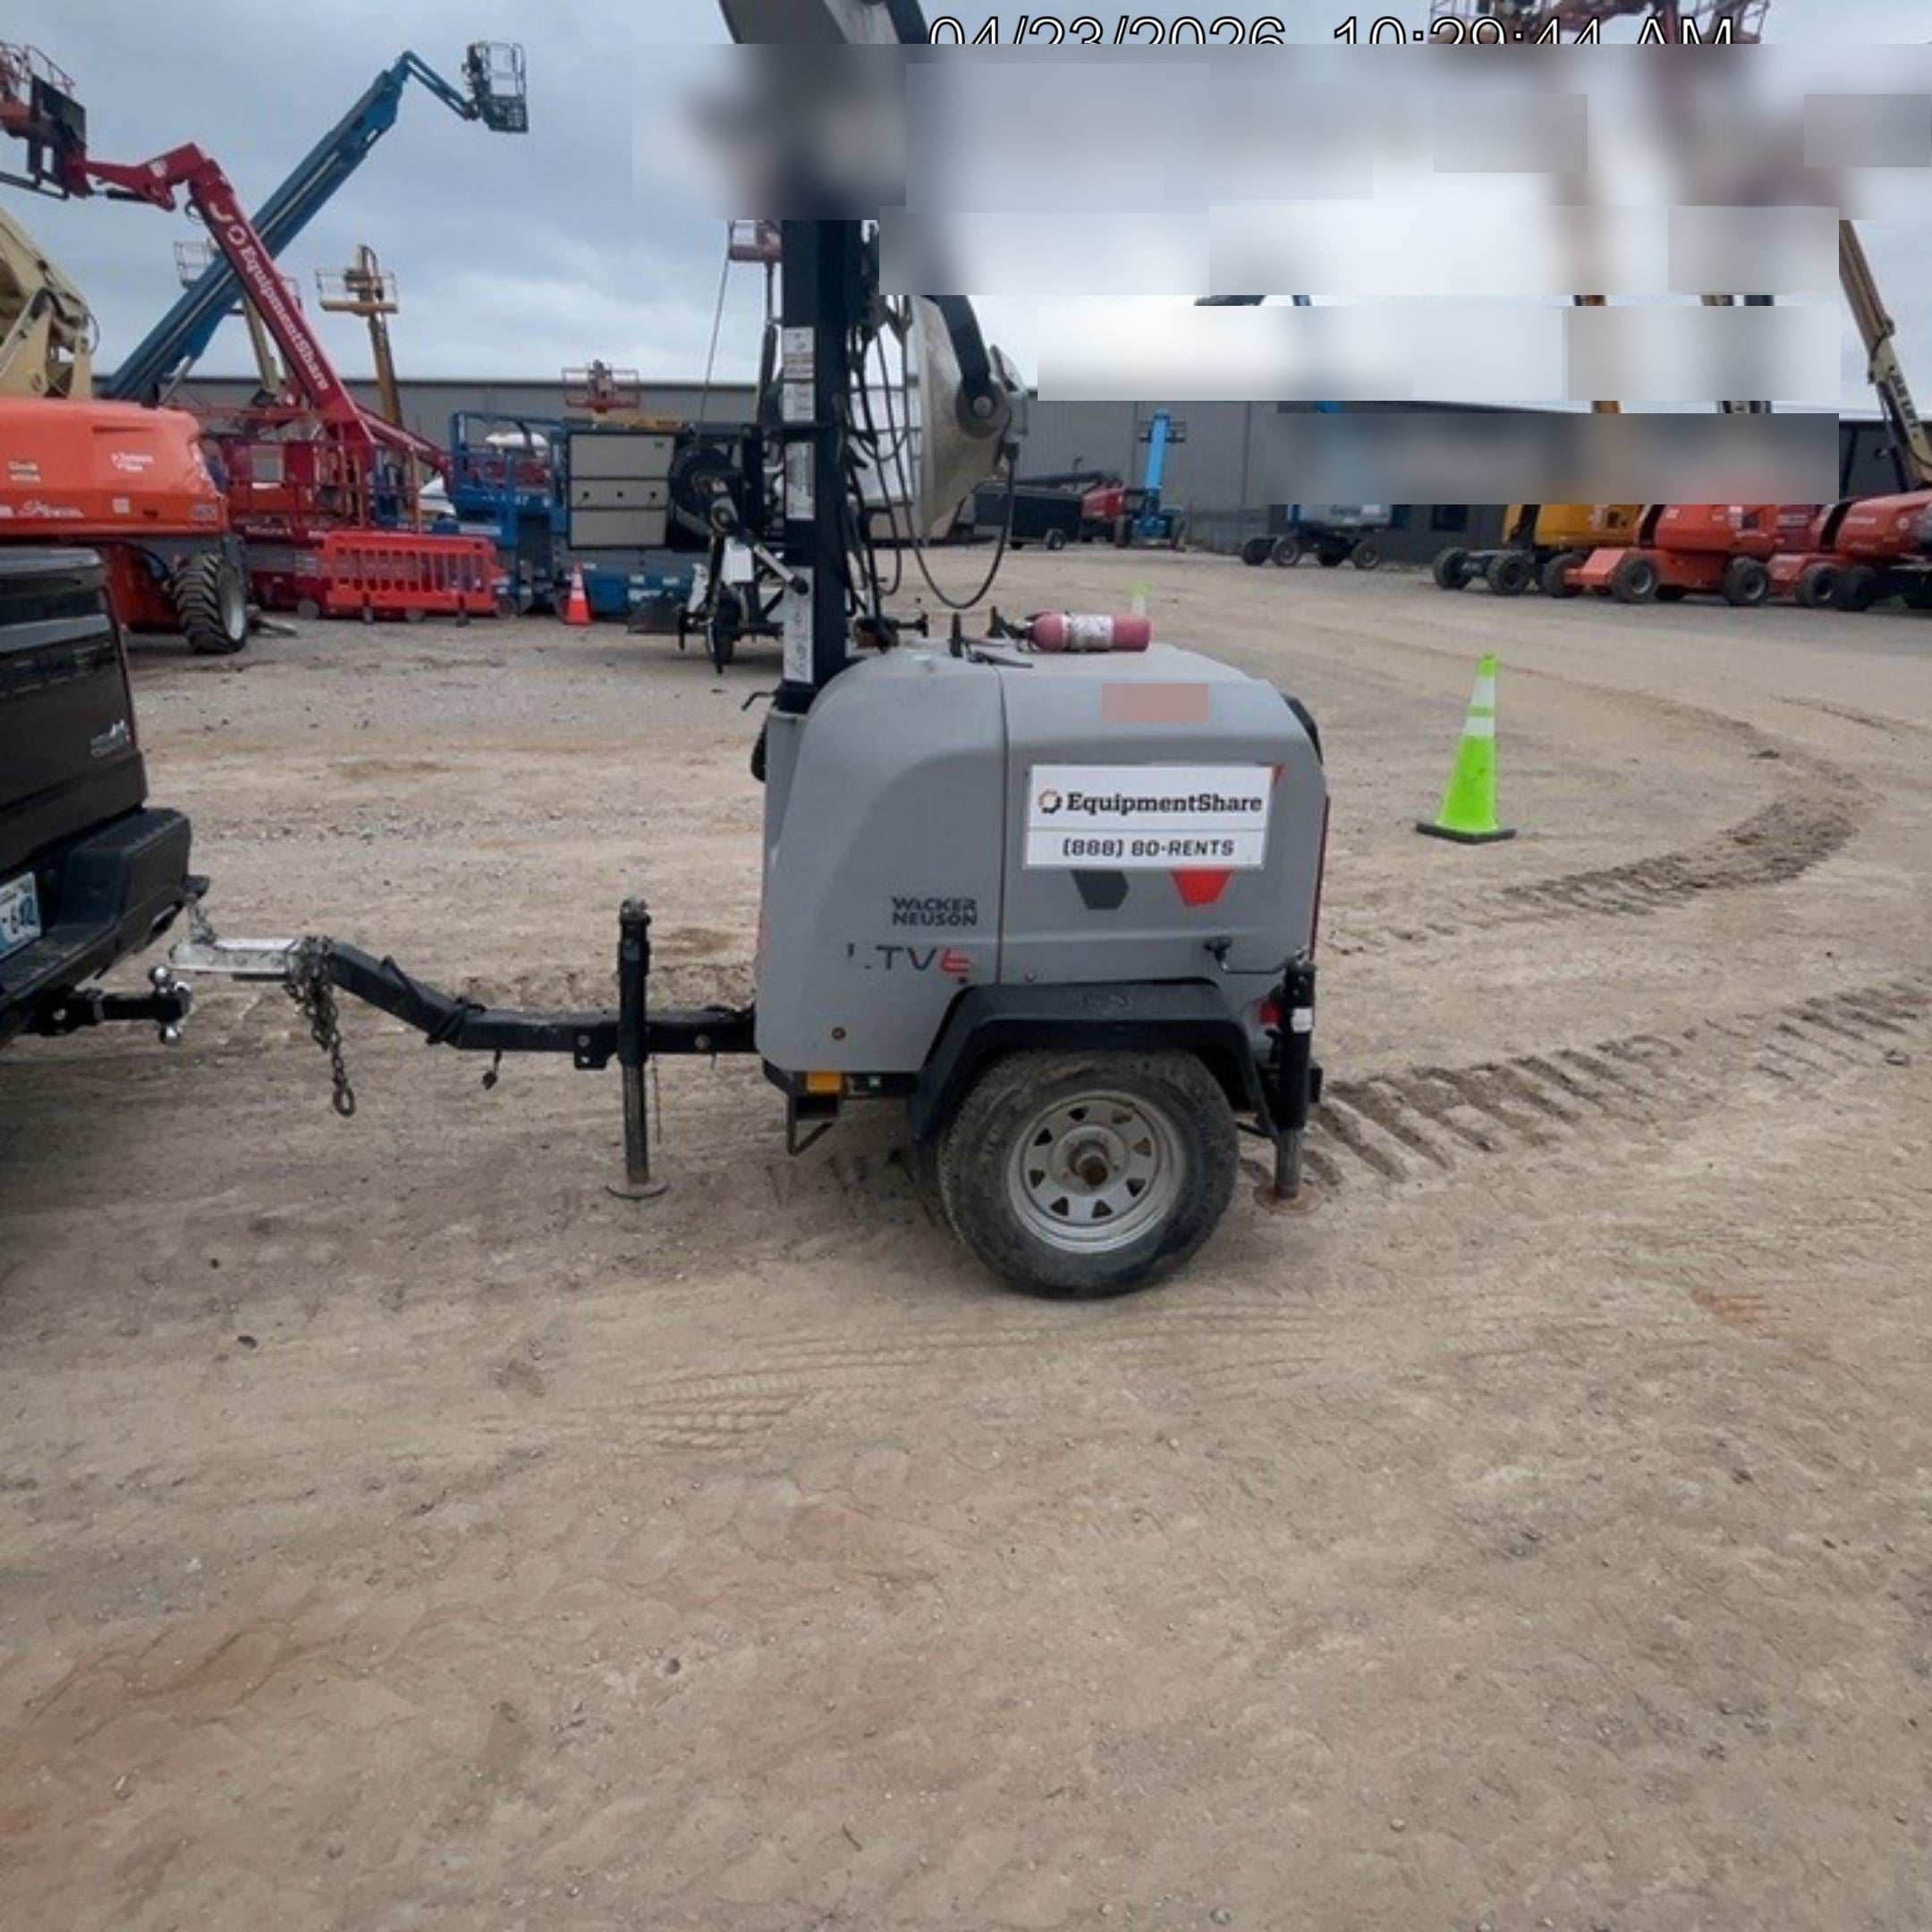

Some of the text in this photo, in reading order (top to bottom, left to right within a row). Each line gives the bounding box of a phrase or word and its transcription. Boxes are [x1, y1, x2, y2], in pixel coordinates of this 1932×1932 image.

[1065, 792, 1263, 816] EquipmentShare
[1062, 838, 1235, 858] (888) 80-RENTS
[892, 897, 977, 911] WACKER
[892, 911, 978, 926] NEUSON
